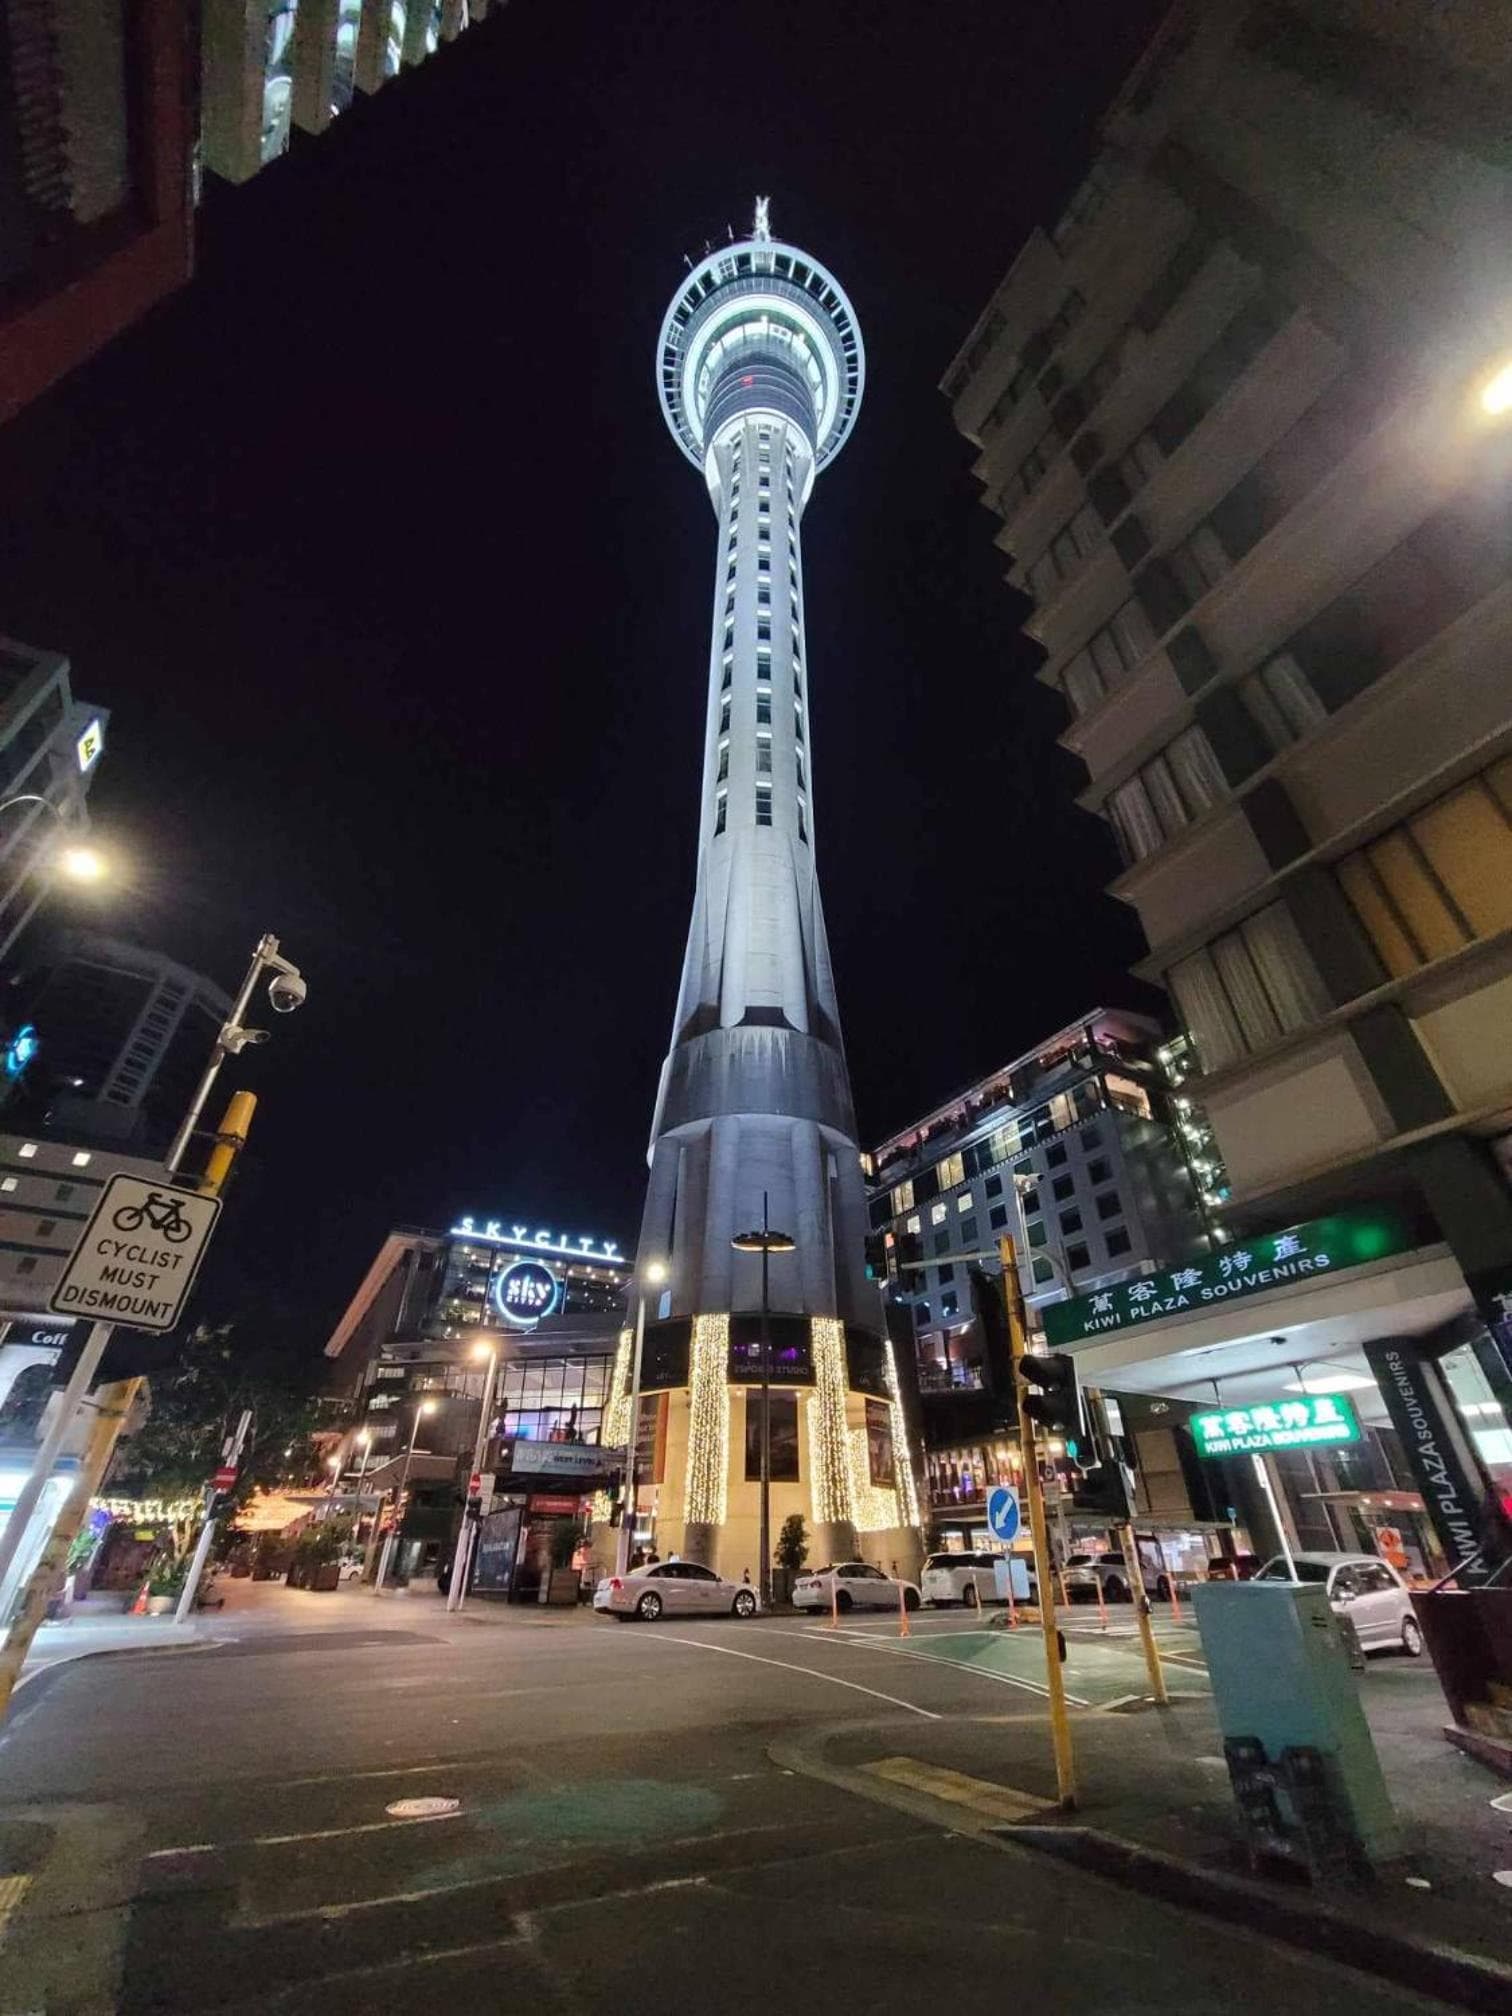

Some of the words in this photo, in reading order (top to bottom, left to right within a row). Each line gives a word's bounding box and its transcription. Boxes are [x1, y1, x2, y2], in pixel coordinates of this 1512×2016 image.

[97, 1238, 184, 1270] CYCLIST
[460, 1216, 618, 1257] SKYCITY
[100, 1266, 160, 1290] MUST
[1084, 1313, 1121, 1332] KIWI
[1130, 1295, 1190, 1319] PLAZA
[1201, 1254, 1331, 1301] SOUVENIRS
[1088, 1233, 1308, 1315] 萬客隆特產
[63, 1286, 173, 1320] DISMOUNT
[1385, 1351, 1433, 1440] SOUVENIRS
[1232, 1432, 1271, 1450] PLAZA
[1418, 1441, 1464, 1514] PLAZA
[1447, 1520, 1488, 1576] KIWI
